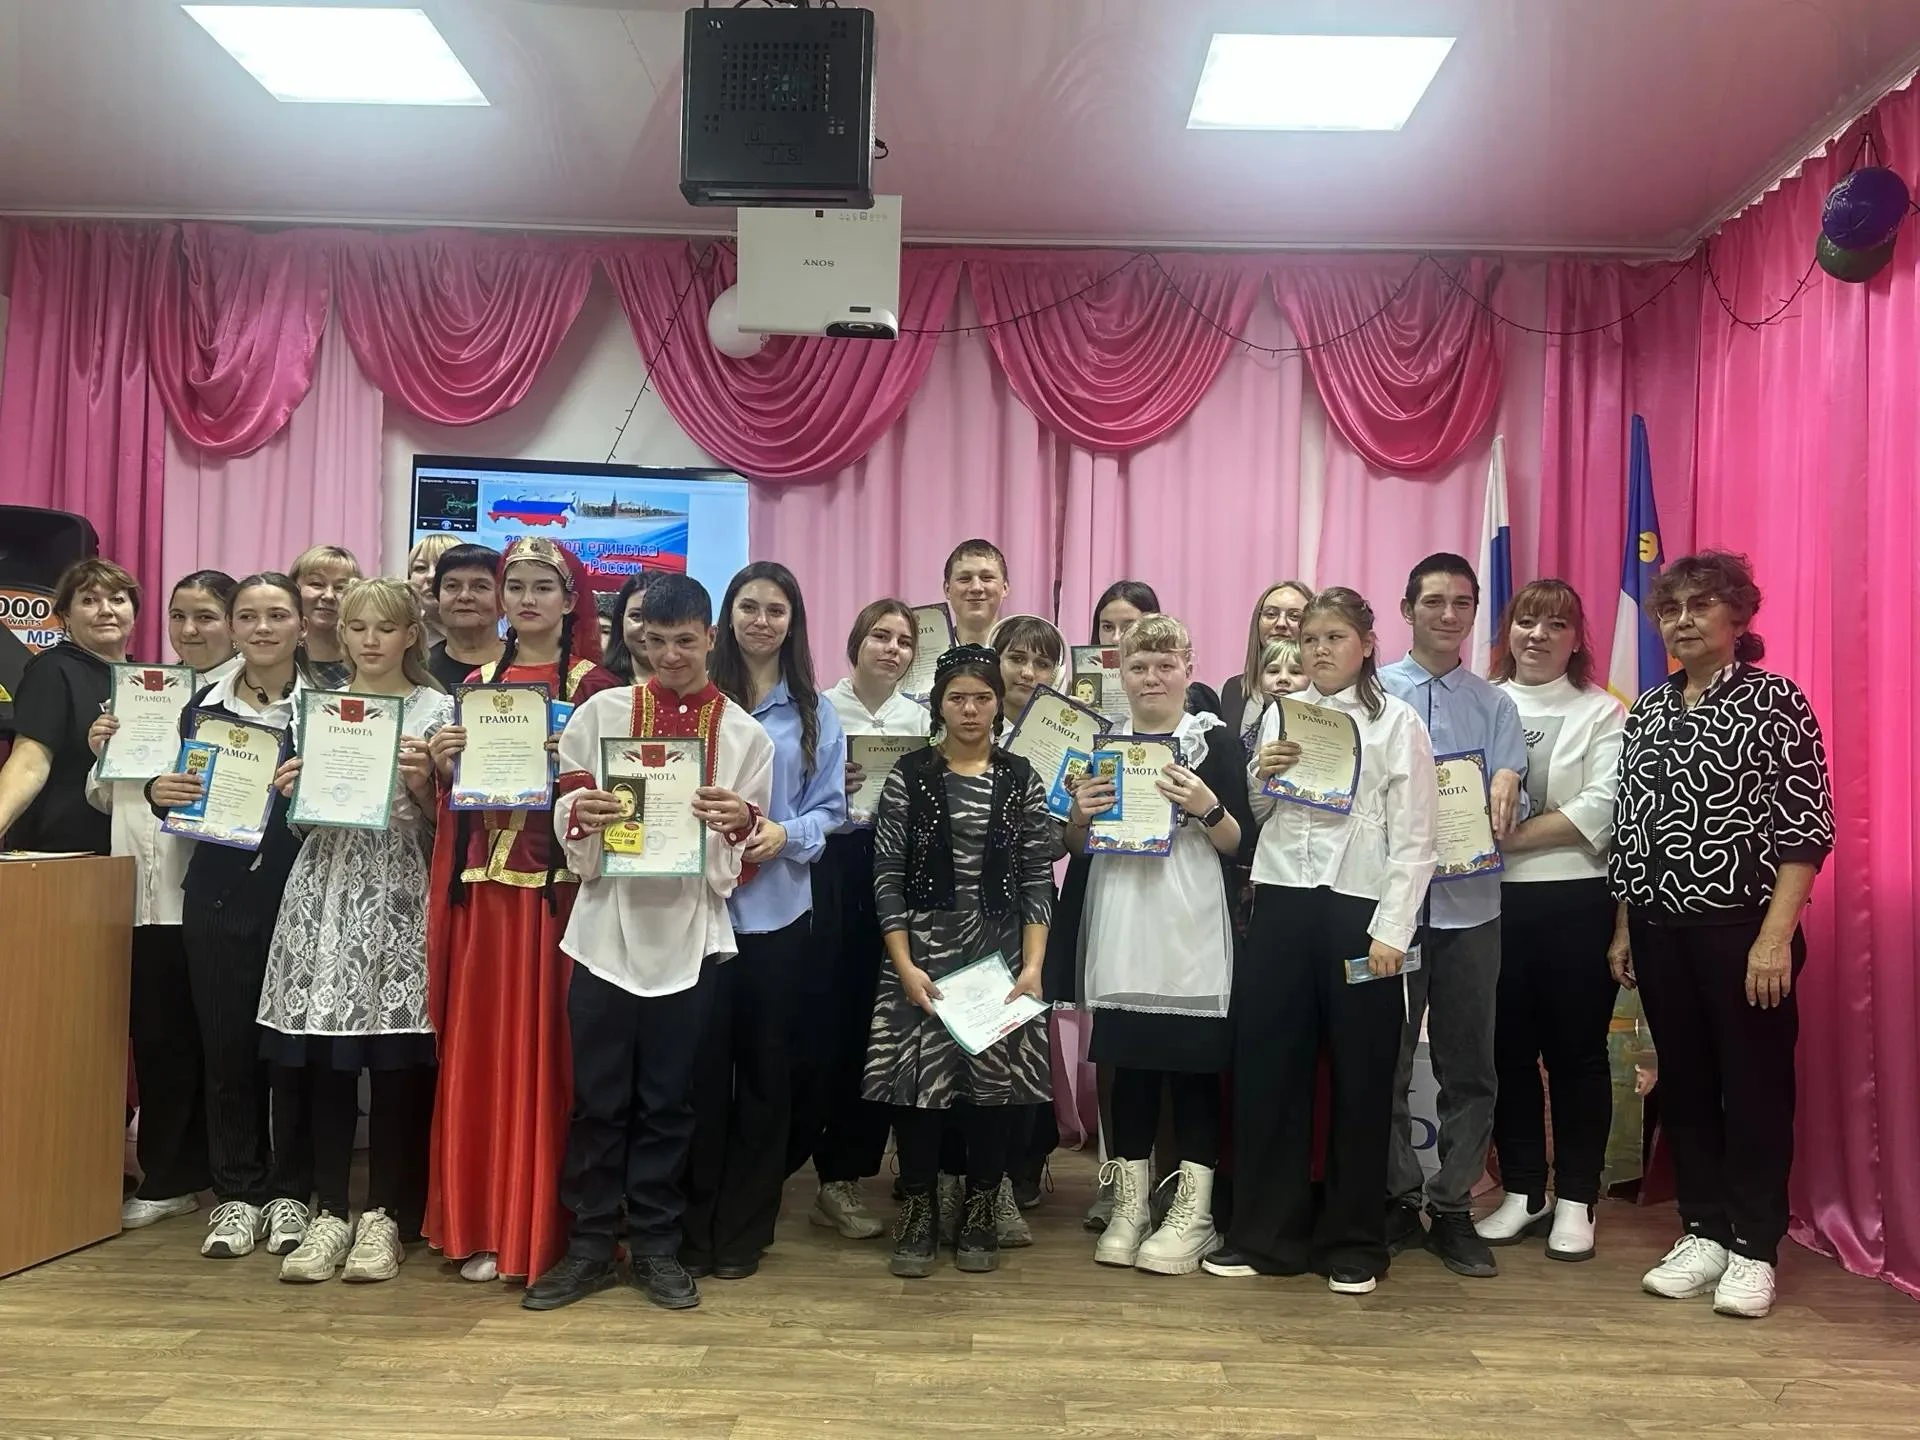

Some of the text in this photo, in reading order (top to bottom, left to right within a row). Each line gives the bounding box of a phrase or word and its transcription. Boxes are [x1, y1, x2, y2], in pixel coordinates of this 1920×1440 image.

[802, 259, 835, 267] SONY
[586, 542, 658, 557] единства
[588, 557, 643, 575] России
[7, 618, 43, 627] WATTS
[134, 694, 172, 704] ГРАМОТА
[479, 715, 529, 724] ГРАМОТА
[1296, 712, 1339, 729] ГРАМОТА
[328, 725, 373, 736] ГРАМОТА
[1041, 716, 1081, 742] ГРАМОТА
[218, 747, 260, 763] РАМОТА
